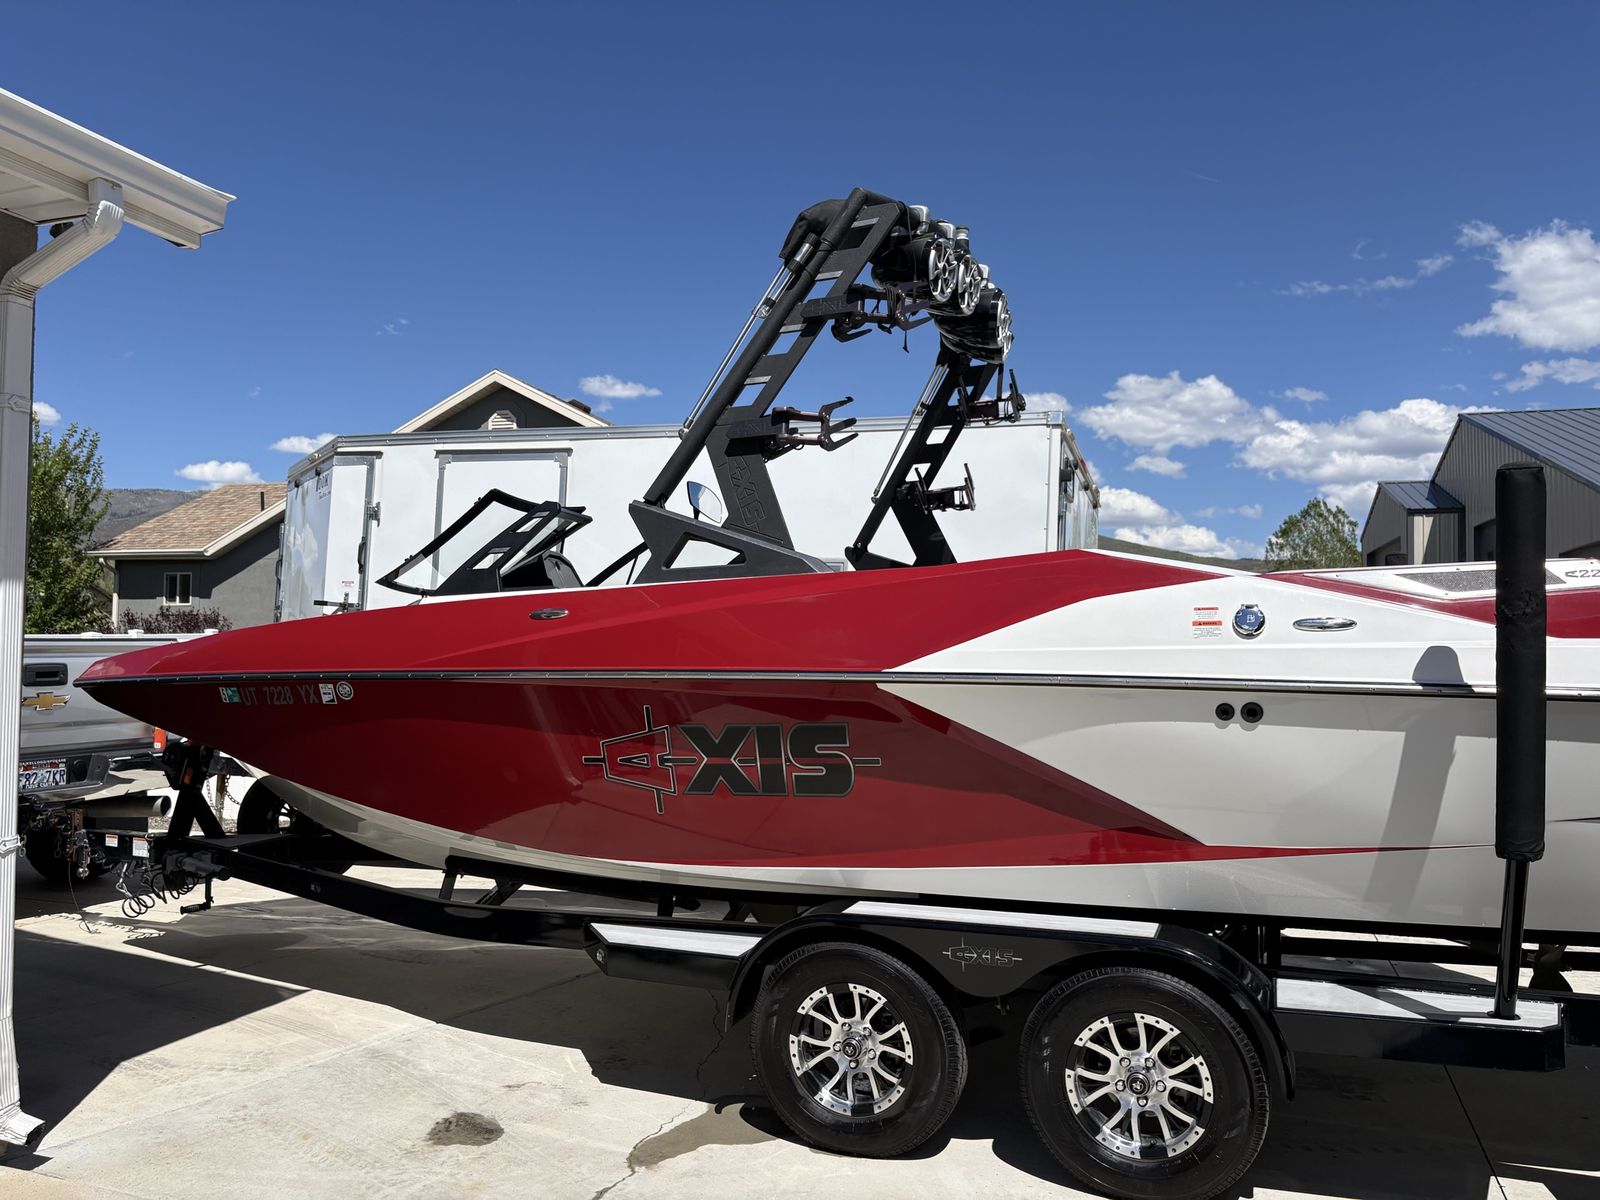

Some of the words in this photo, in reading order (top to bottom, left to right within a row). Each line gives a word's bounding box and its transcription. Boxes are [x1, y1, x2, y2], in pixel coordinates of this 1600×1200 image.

[241, 687, 258, 705] UT
[263, 687, 293, 704] 7228
[297, 685, 318, 704] YX
[585, 718, 879, 798] AXIS
[943, 943, 1022, 969] AXIS
